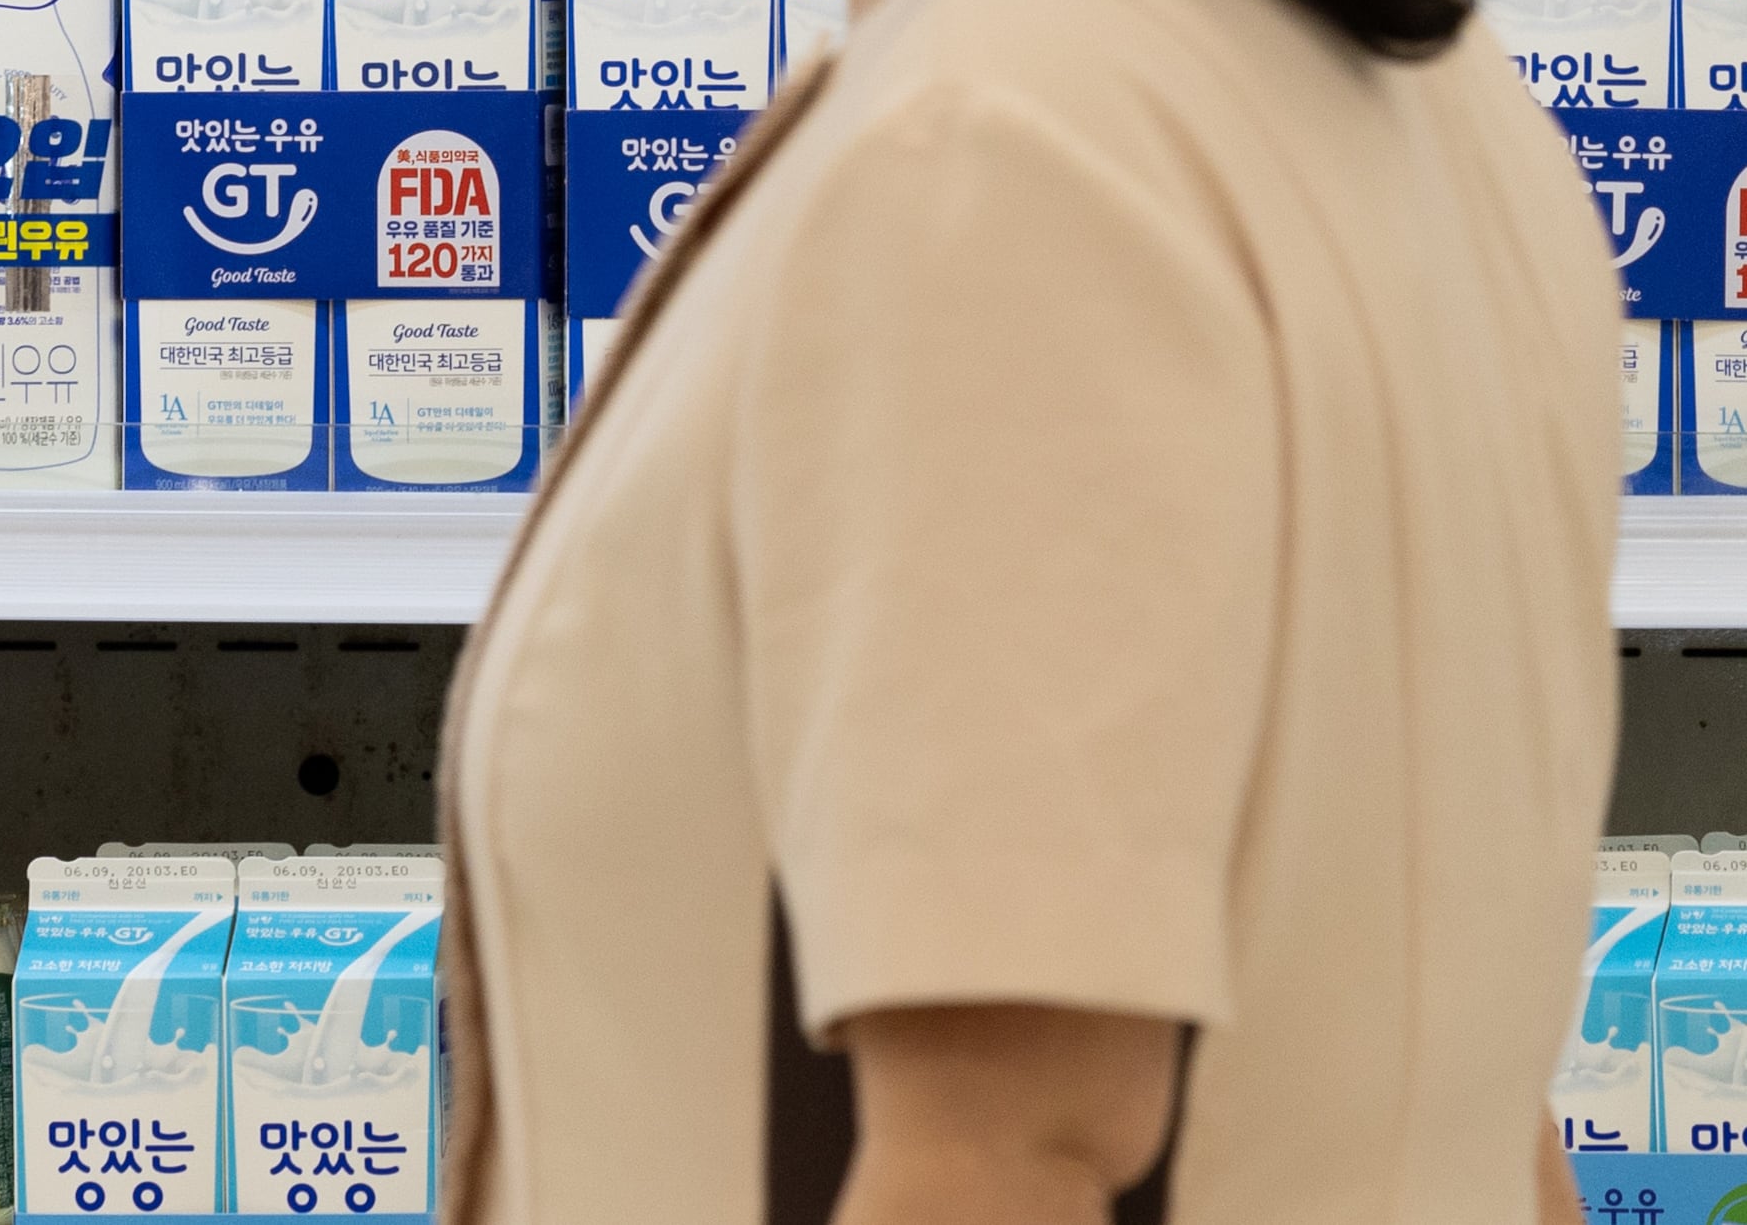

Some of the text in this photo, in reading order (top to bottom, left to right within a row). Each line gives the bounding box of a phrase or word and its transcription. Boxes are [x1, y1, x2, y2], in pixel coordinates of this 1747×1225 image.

[175, 118, 324, 154] 맛있는 우유
[202, 163, 296, 218] GT
[390, 167, 491, 216] FDA
[211, 265, 296, 288] Good Taste
[387, 243, 457, 279] 120
[185, 317, 270, 336] Good Taste
[160, 346, 293, 365] 대한민국 최고등급
[28, 959, 122, 972] 고소한 저지방
[49, 1118, 194, 1175] 맛있는
